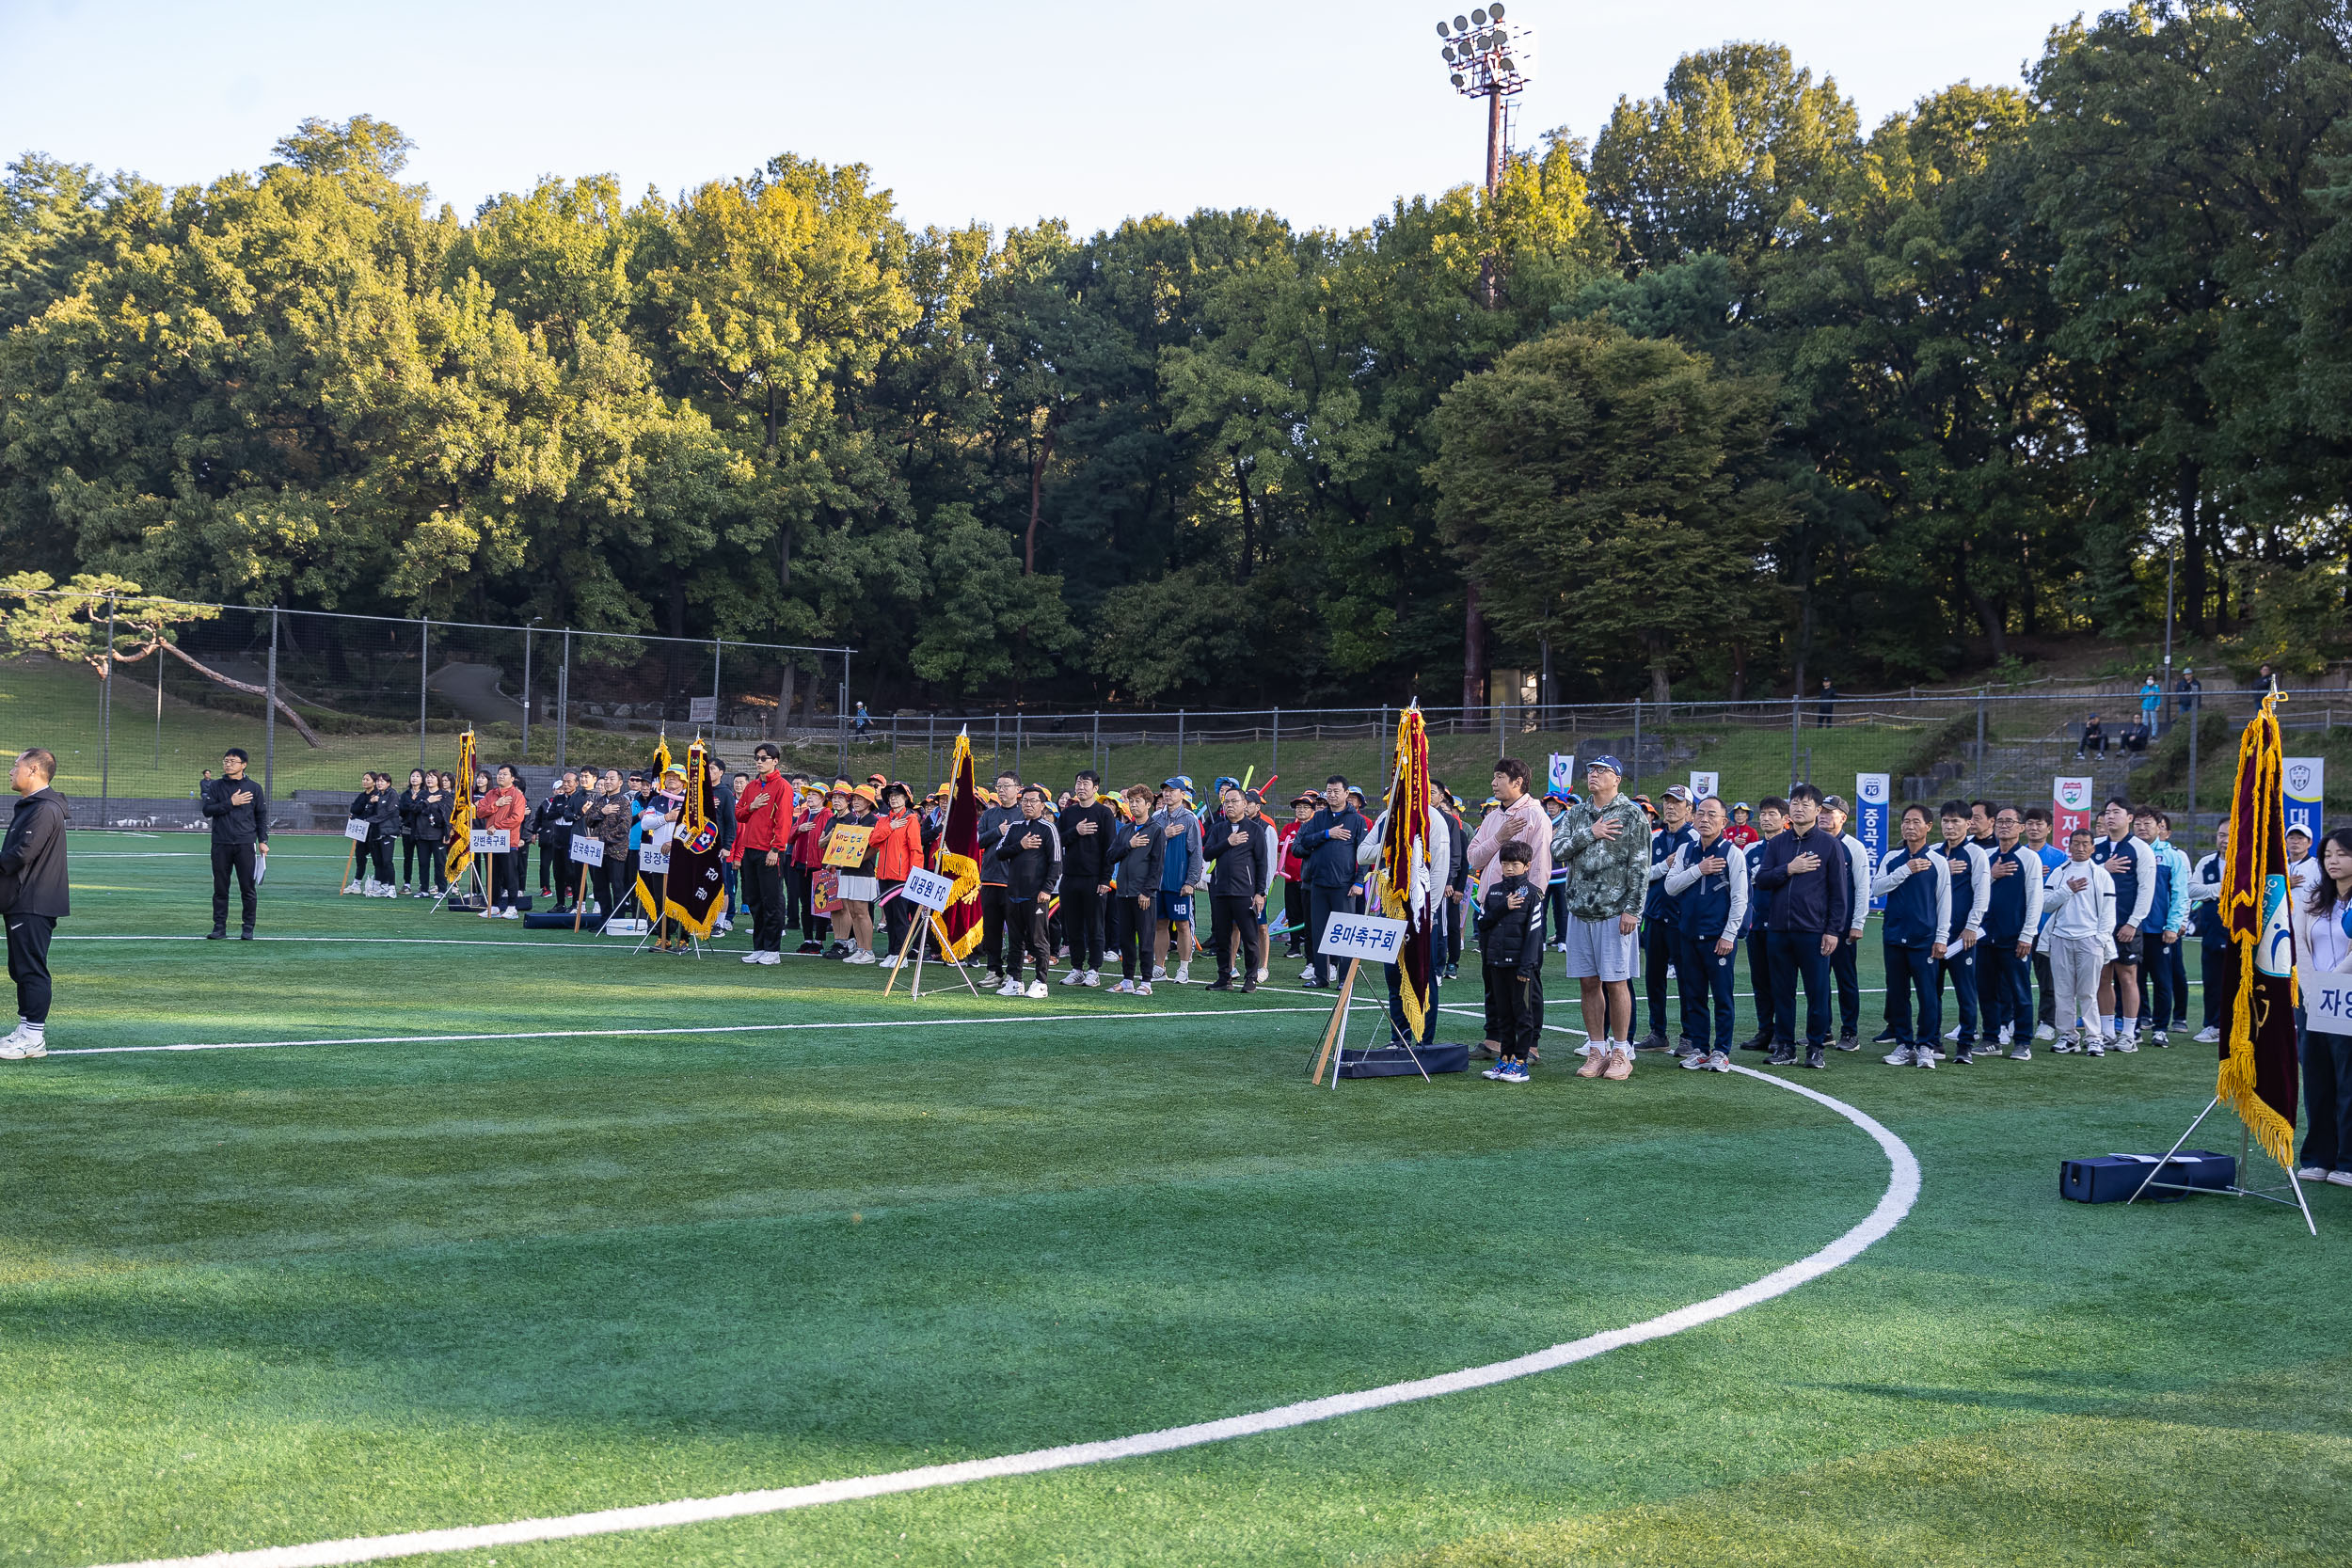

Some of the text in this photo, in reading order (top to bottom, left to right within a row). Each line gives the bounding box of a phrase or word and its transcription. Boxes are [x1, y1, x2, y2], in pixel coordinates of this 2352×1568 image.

[473, 835, 506, 847] 강변축구회
[573, 841, 602, 859] 건국축구회
[909, 875, 946, 902] 대공원 FC
[1173, 904, 1186, 914] 48
[1329, 923, 1397, 951] 용마축구회
